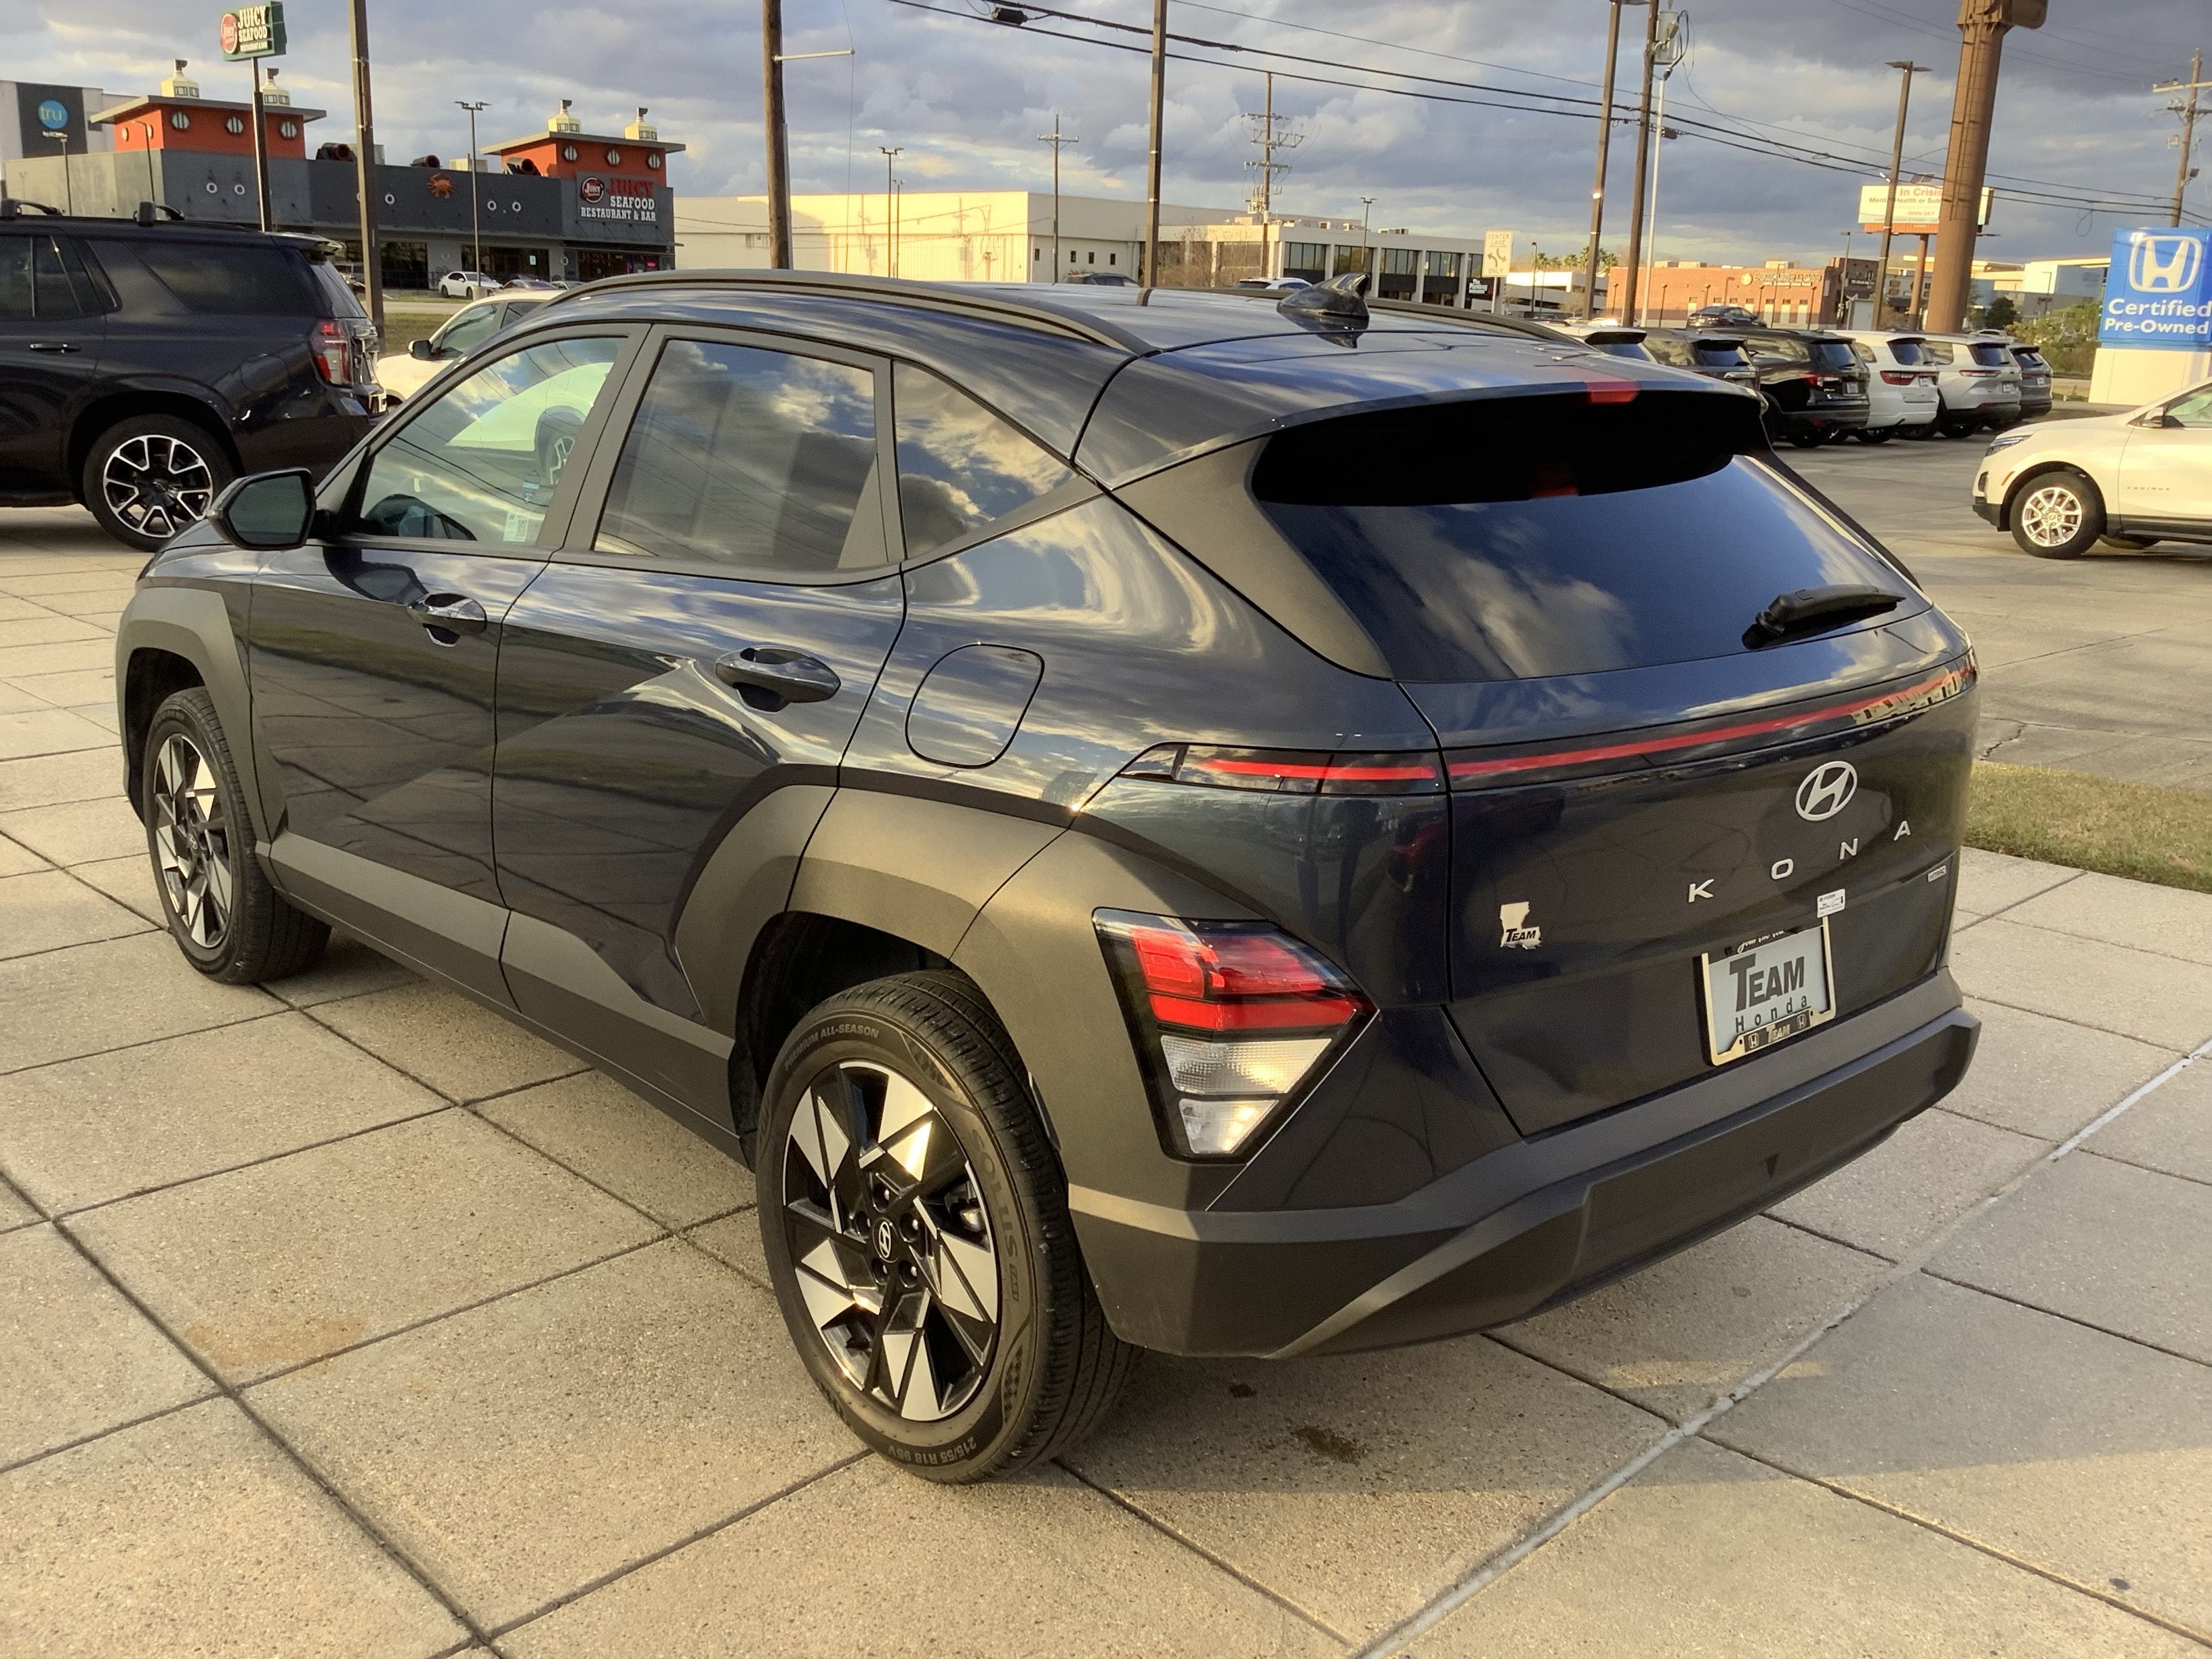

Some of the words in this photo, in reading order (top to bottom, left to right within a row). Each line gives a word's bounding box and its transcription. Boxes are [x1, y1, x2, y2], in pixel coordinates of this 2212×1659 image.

[238, 5, 266, 29] JUICY
[238, 25, 268, 43] SEAFOOD
[39, 106, 62, 121] tru
[607, 178, 654, 198] JUICY
[1900, 188, 1910, 197] In
[610, 195, 655, 210] SEAFOOD
[581, 207, 632, 220] RESTAURANT
[633, 211, 639, 220] &
[640, 211, 657, 222] BAR
[2108, 298, 2212, 318] Certified
[2104, 317, 2209, 335] Pre-Owned
[1687, 820, 1911, 903] KONA
[1506, 928, 1537, 943] TEAM
[1729, 953, 1805, 1012] TEAM
[1735, 995, 1807, 1033] Honda
[784, 1032, 819, 1071] PREMIUM
[820, 1023, 879, 1039] ALL-SEASON
[915, 1452, 939, 1465] R18
[940, 1436, 977, 1463] 215/55
